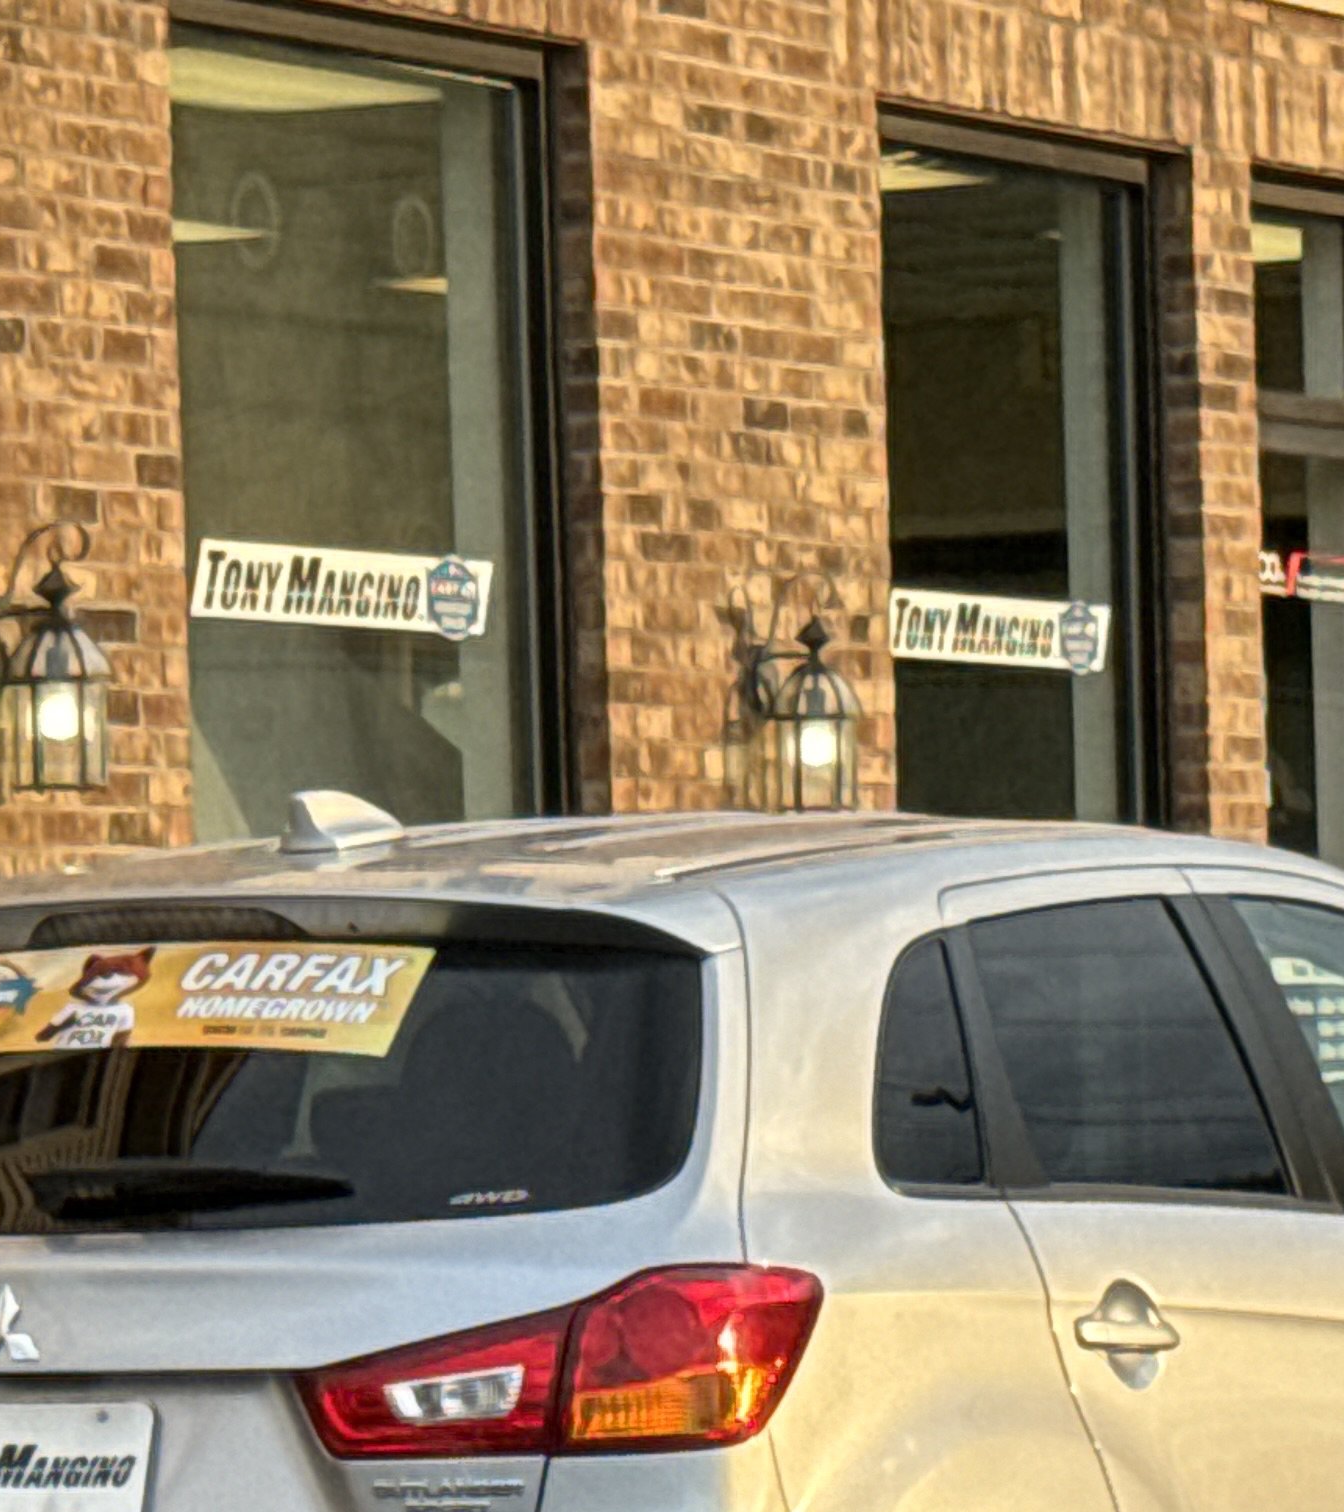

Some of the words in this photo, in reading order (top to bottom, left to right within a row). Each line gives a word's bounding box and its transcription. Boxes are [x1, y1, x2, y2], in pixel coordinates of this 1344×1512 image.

[203, 550, 283, 612] TONY
[893, 598, 952, 653] TONY
[180, 952, 406, 997] CARFAX
[176, 995, 378, 1024] HOMEGROWN
